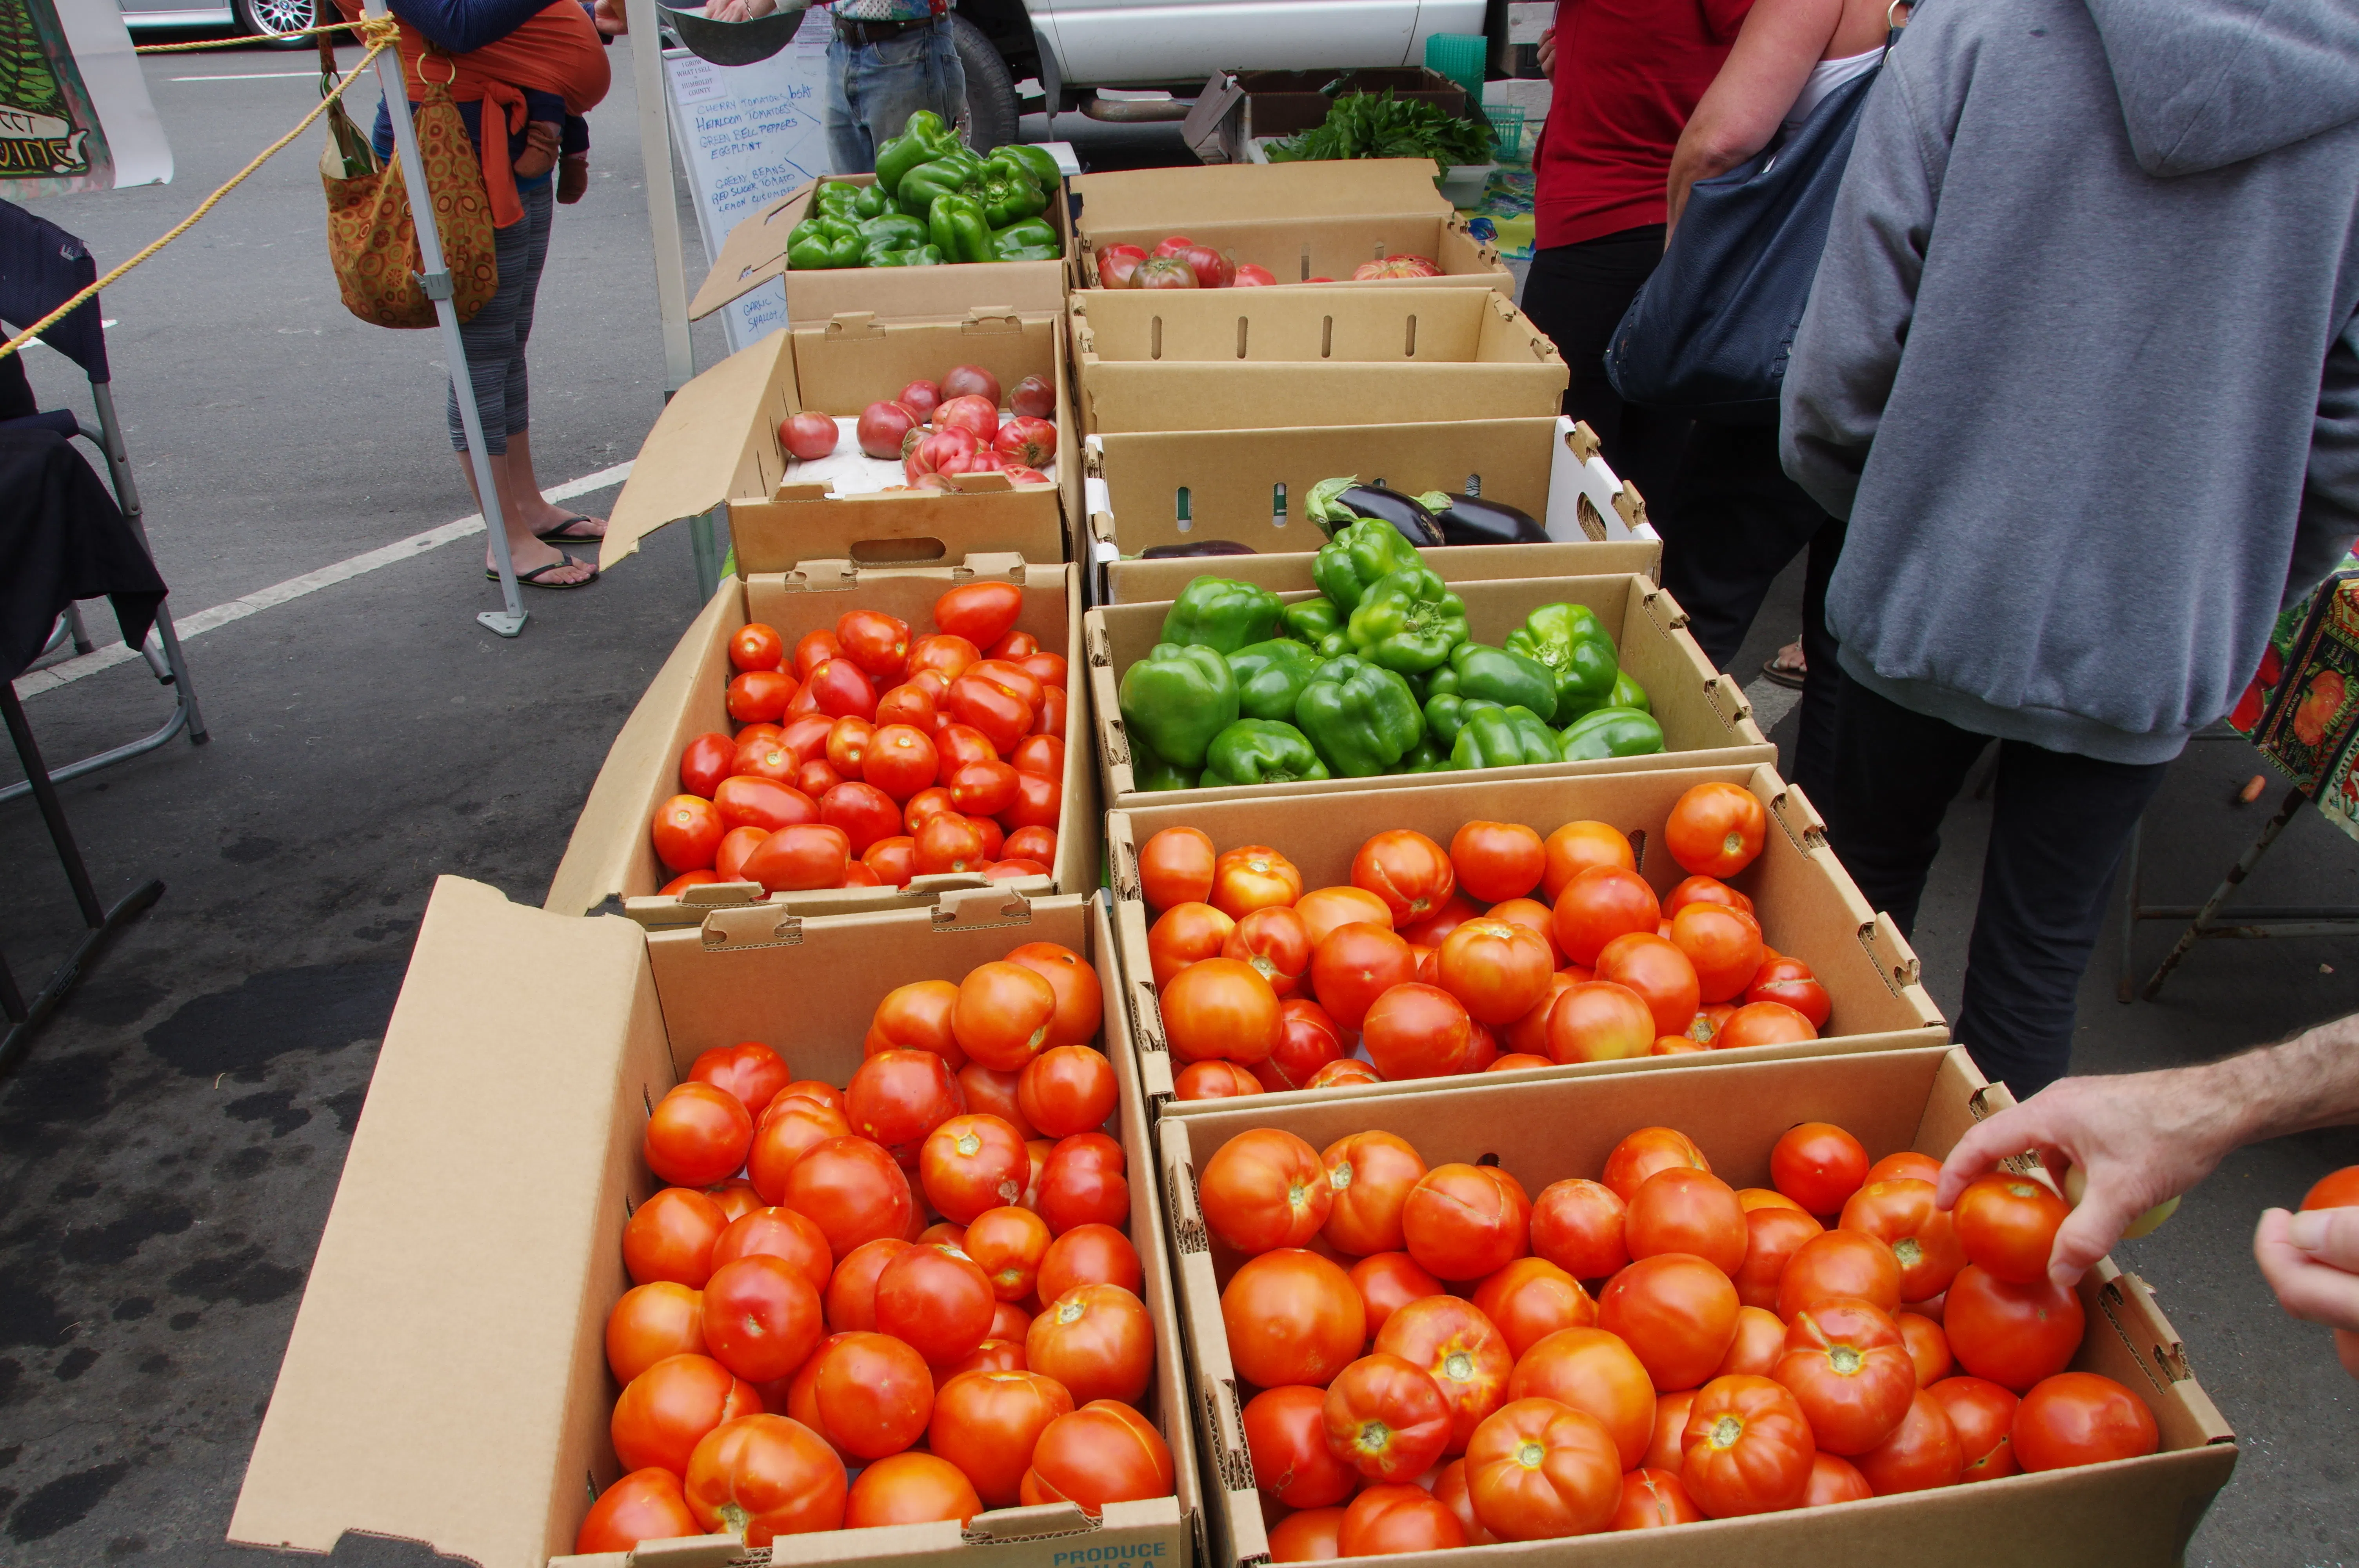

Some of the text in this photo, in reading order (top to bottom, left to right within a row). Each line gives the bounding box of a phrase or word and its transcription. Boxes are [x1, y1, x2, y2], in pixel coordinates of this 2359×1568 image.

[686, 59, 702, 67] GROW
[677, 69, 694, 77] WHAT
[682, 78, 712, 89] HUMBOLDT
[689, 86, 711, 96] COUNTY
[697, 100, 736, 115] CHERRY
[741, 93, 789, 107] TOMATOES
[696, 114, 742, 132] HEIRLOOM
[700, 133, 731, 148] GREEN
[759, 118, 798, 134] PEPPERS
[711, 142, 763, 160] EGGPLANT
[716, 164, 786, 189] GREEN BEANS
[712, 174, 795, 205] RED SLICER TOMATO
[718, 197, 746, 212] LEMON
[743, 299, 772, 316] GARLIC
[2286, 693, 2301, 718] BRAND
[2321, 680, 2359, 735] PUMPKIN
[1054, 1542, 1166, 1566] PRODUCE
